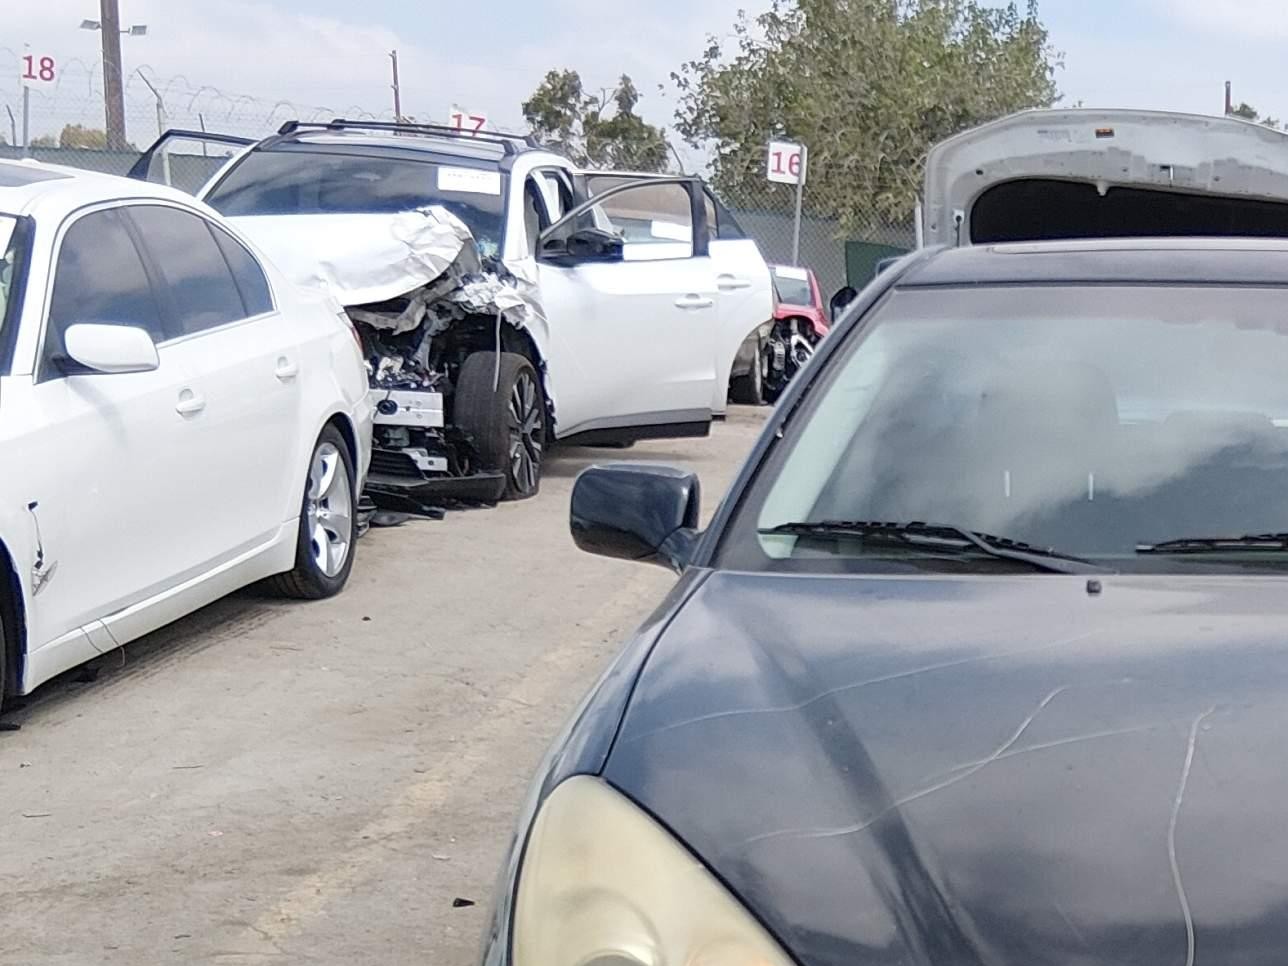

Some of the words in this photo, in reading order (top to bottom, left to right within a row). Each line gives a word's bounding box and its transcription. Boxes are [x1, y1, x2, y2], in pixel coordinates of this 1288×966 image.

[22, 55, 55, 82] 18
[452, 114, 486, 137] 17
[771, 151, 801, 178] 16
